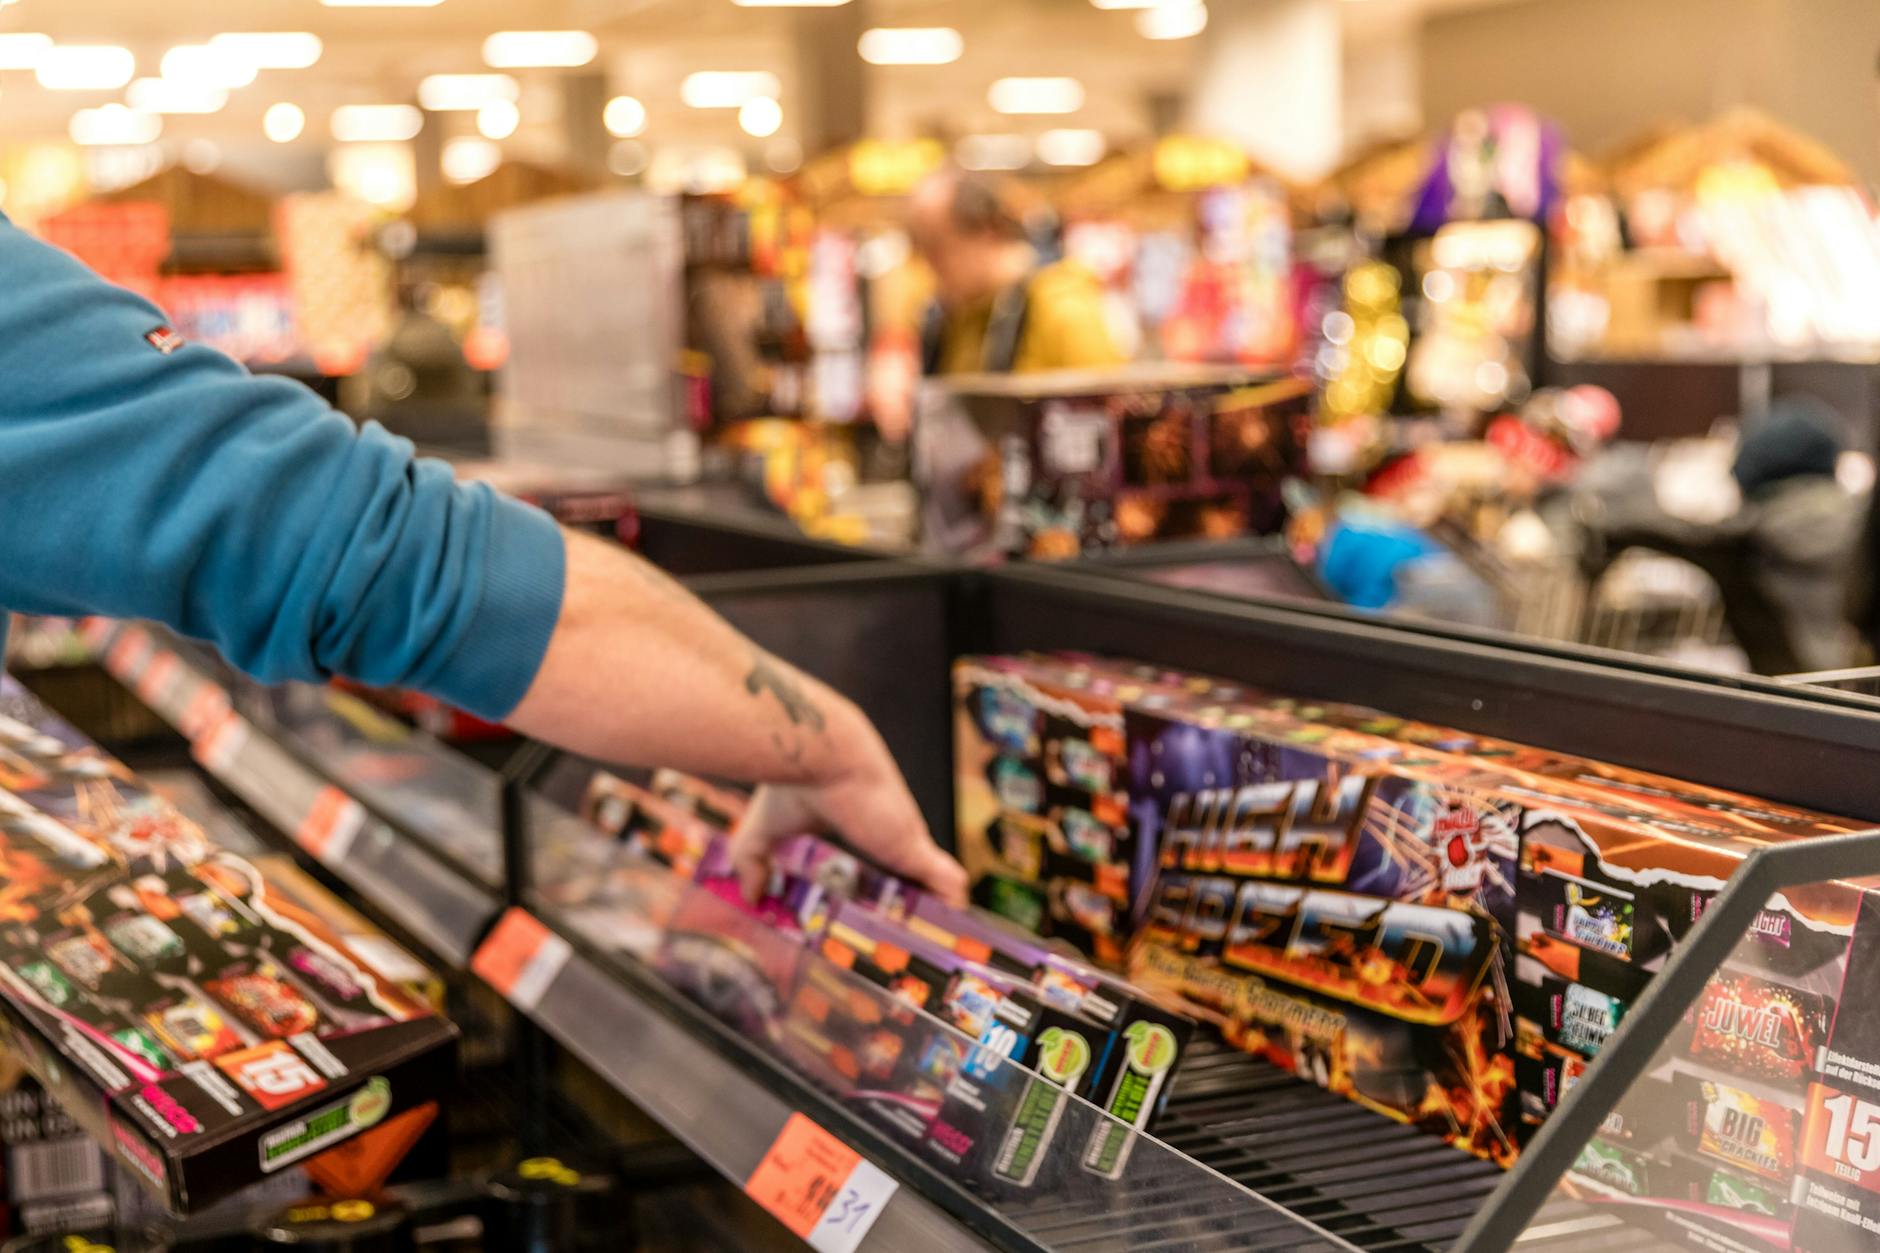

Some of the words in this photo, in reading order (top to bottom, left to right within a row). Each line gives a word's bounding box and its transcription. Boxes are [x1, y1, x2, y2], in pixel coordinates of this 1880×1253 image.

[1160, 775, 1370, 883] HIGH
[1705, 997, 1782, 1048] JUWEL
[1722, 1107, 1764, 1149] BIG
[1824, 1094, 1880, 1172] 15
[1835, 1162, 1861, 1182] TEILIG
